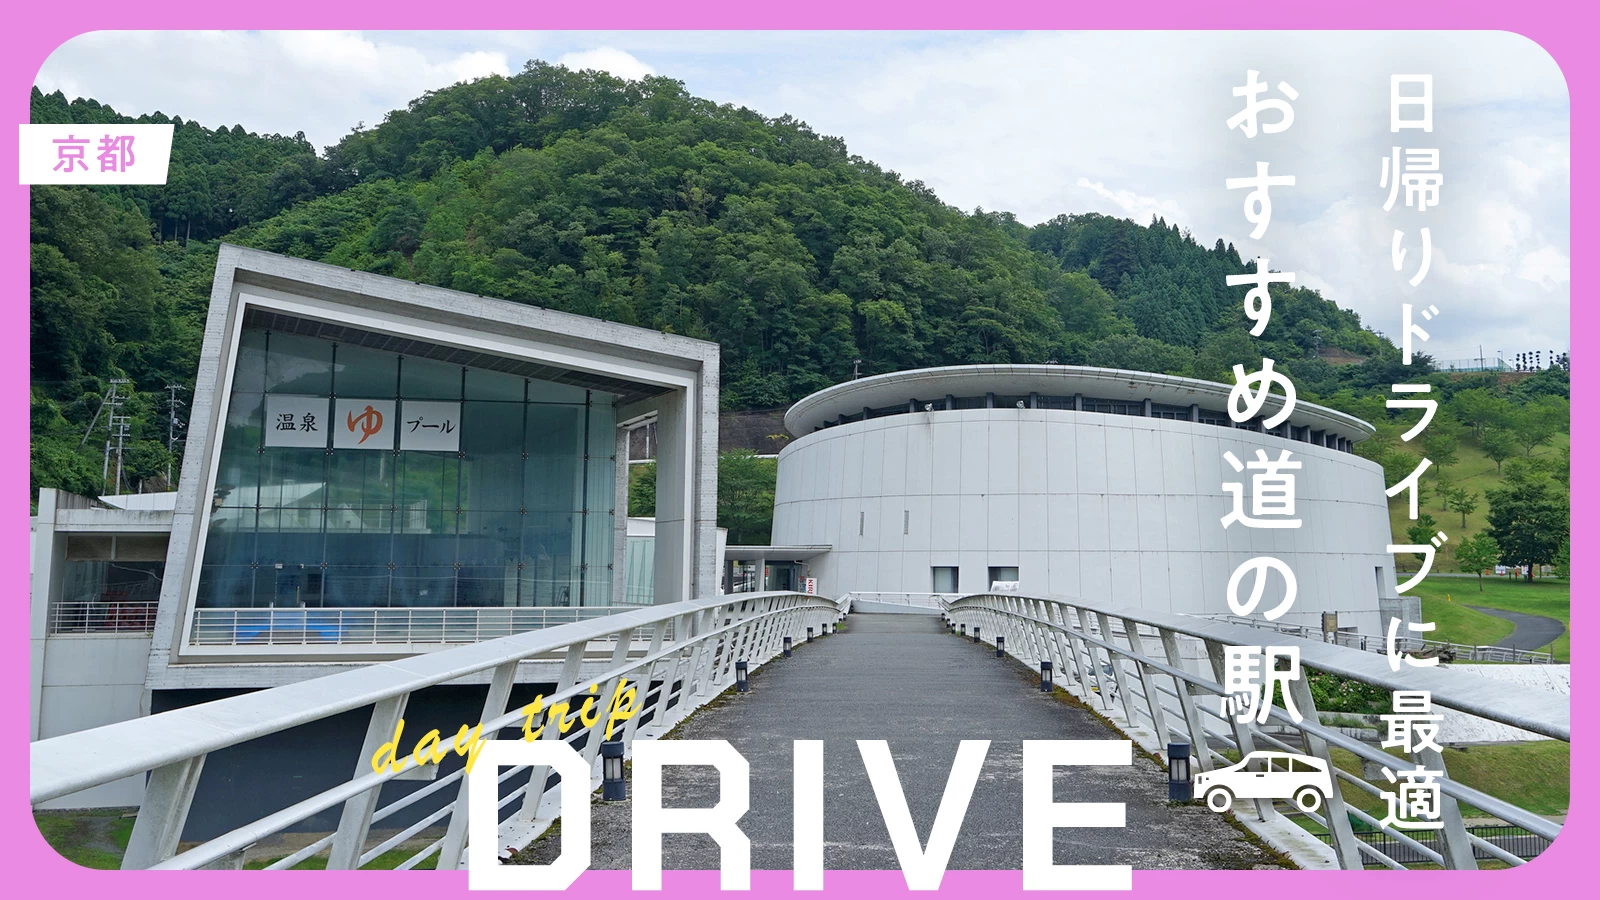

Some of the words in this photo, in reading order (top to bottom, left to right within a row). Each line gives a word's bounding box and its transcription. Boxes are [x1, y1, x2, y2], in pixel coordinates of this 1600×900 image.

[275, 412, 318, 433] 温泉
[347, 405, 384, 445] ゆ
[406, 416, 456, 434] プール
